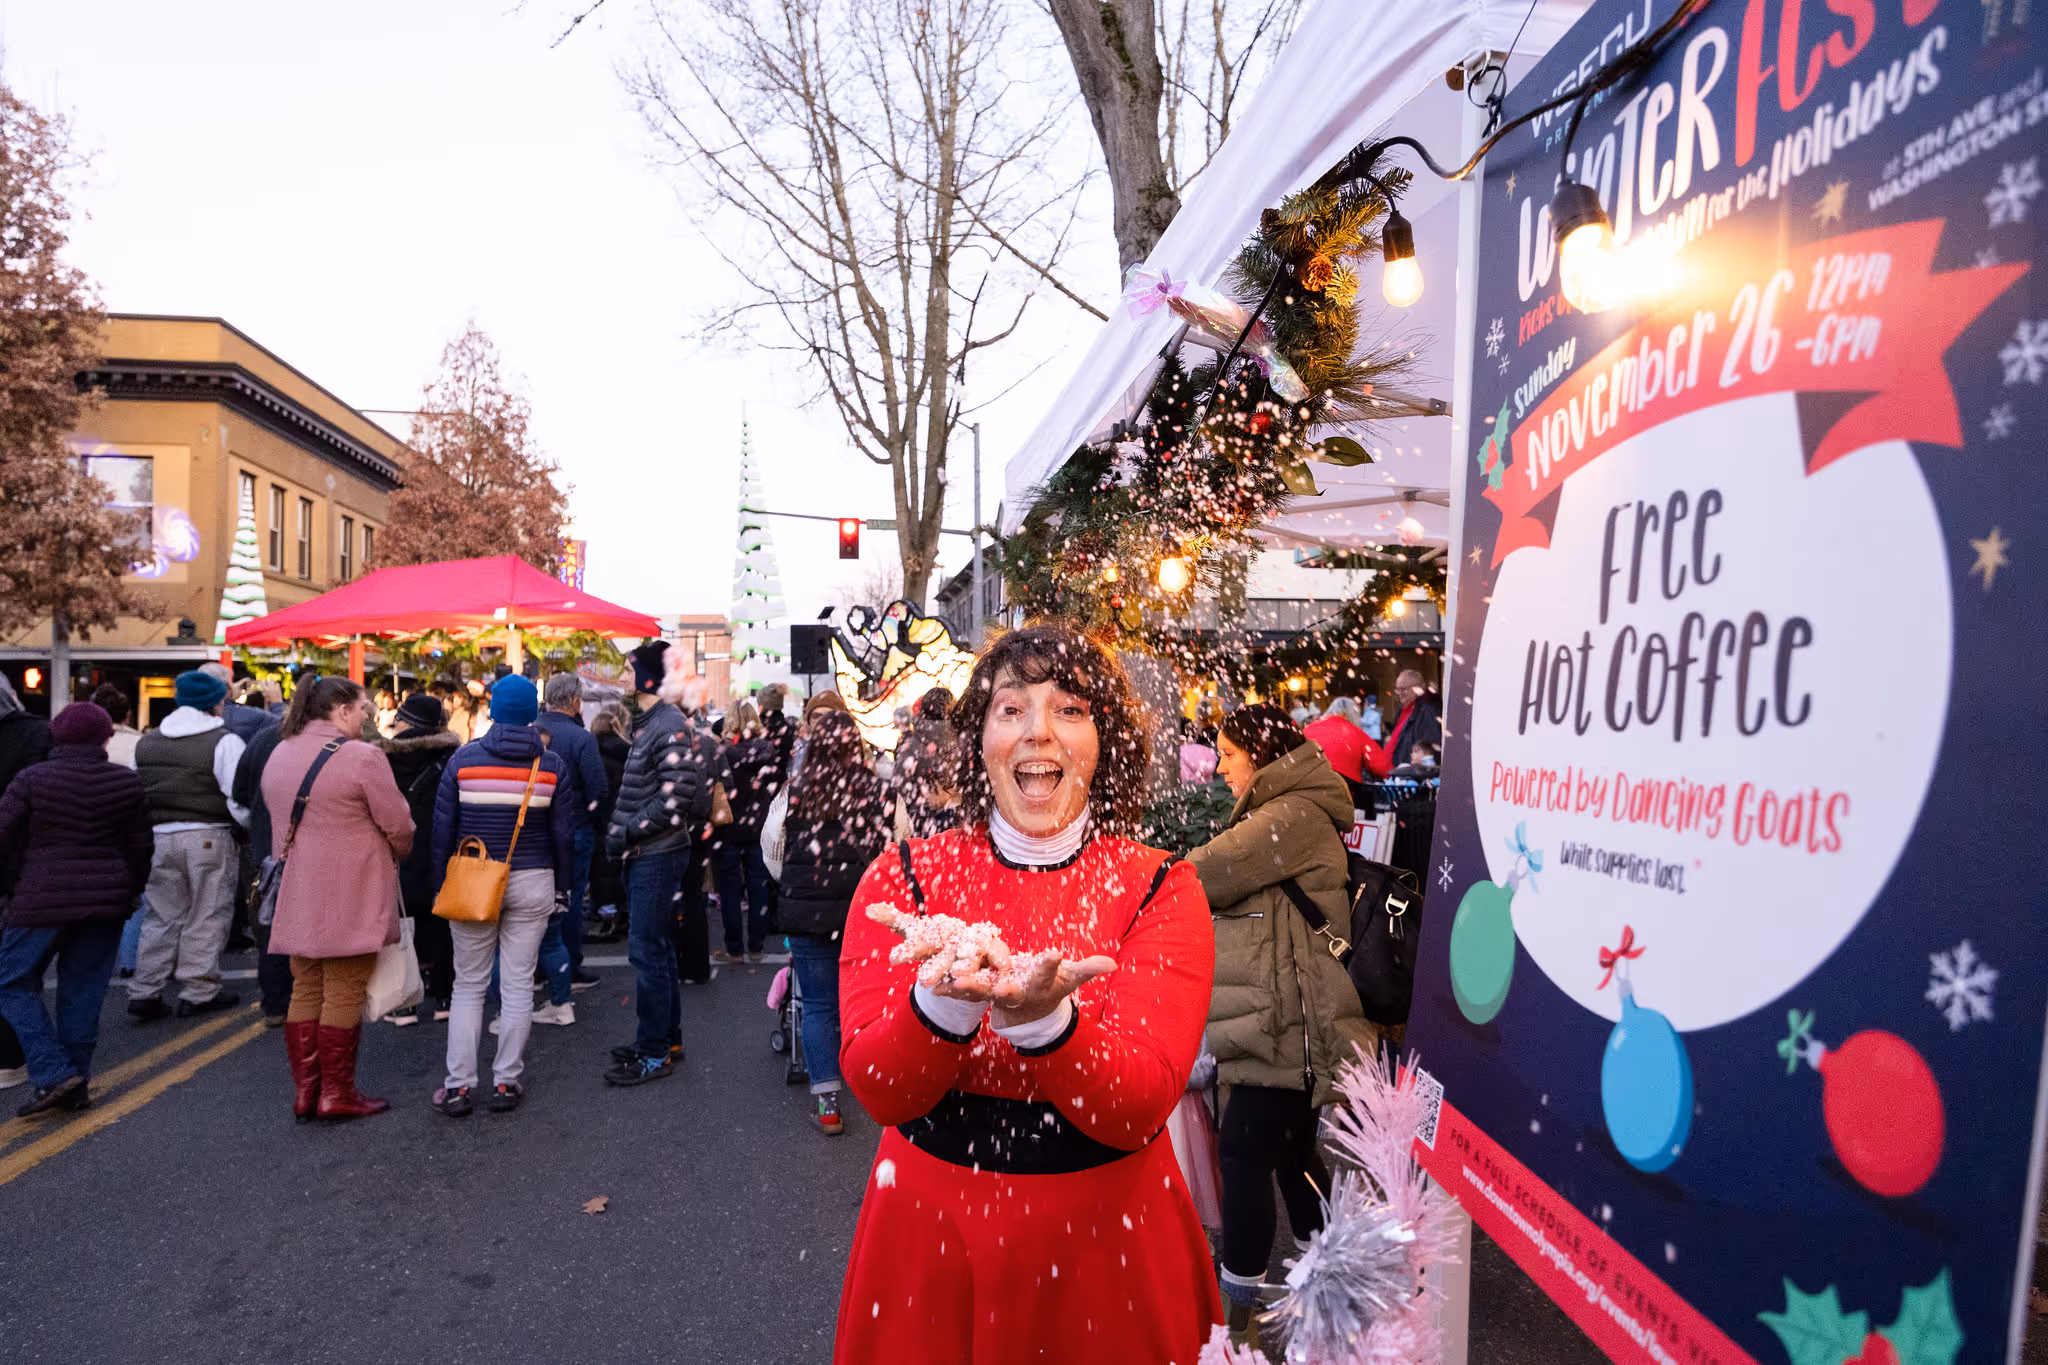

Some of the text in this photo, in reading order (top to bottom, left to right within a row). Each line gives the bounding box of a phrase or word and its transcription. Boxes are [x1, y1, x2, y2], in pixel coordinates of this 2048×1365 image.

[1769, 25, 1947, 200] Holidays
[1868, 107, 2022, 211] WASHINGTON
[1903, 126, 1947, 168] 5TH
[1948, 95, 1997, 147] AVE
[1719, 270, 1794, 388] 26
[1806, 252, 1892, 312] 12PM
[1490, 761, 1851, 854] Powered by Dancing Goats
[1450, 1128, 1471, 1155] FOR
[1484, 1157, 1510, 1191] FULL
[1514, 1184, 1580, 1254] SCHEDULE
[1587, 1249, 1607, 1273] OF
[1614, 1273, 1679, 1344] EVENTS
